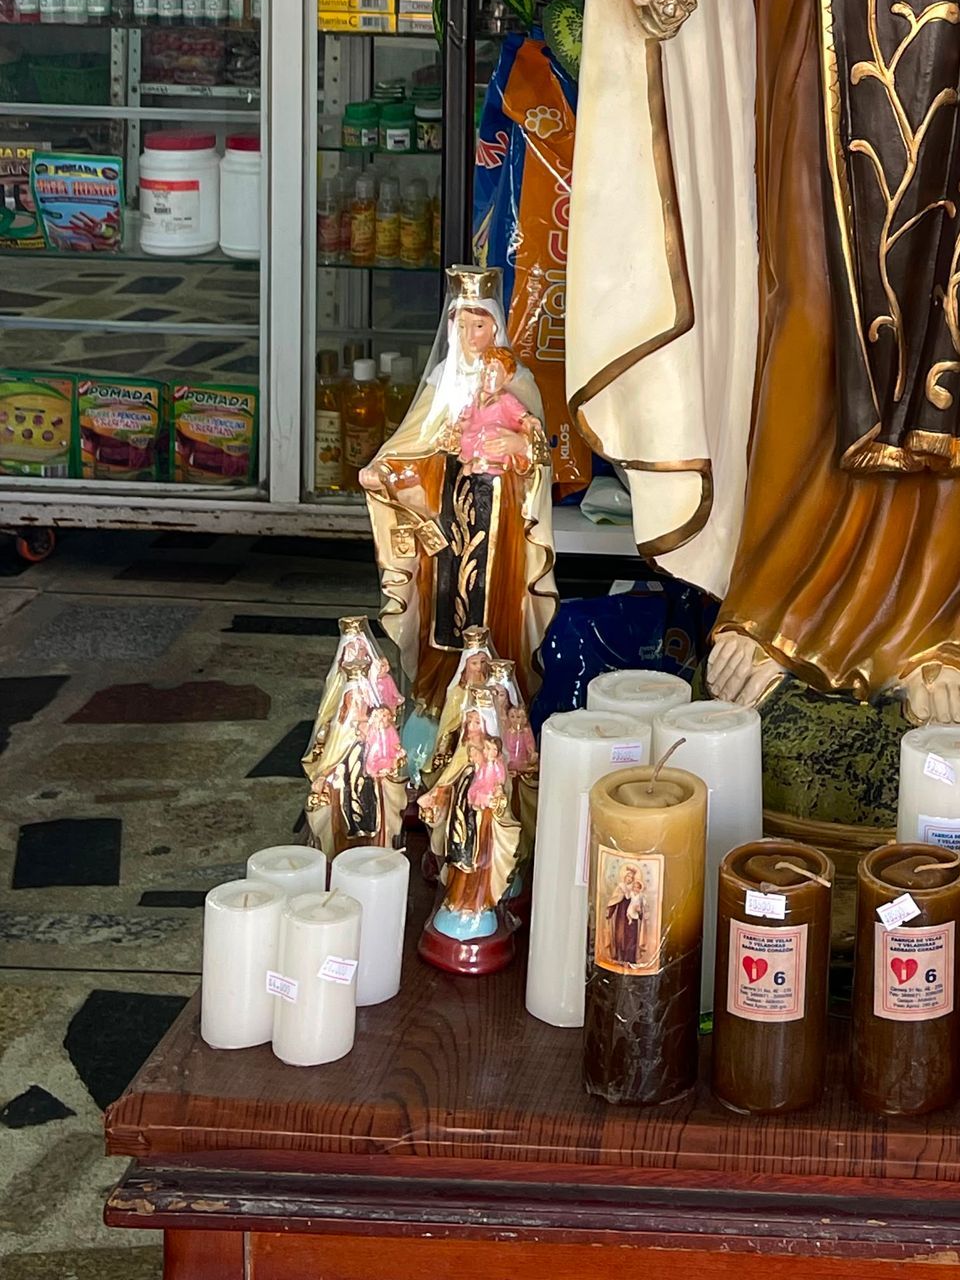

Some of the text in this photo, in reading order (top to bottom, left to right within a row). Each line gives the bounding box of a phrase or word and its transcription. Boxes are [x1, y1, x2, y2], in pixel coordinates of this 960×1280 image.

[349, 16, 358, 27] C
[55, 164, 98, 176] POMADA
[89, 385, 153, 401] POMADA
[184, 391, 249, 408] POMADA
[773, 970, 786, 986] 6
[924, 968, 937, 983] 6
